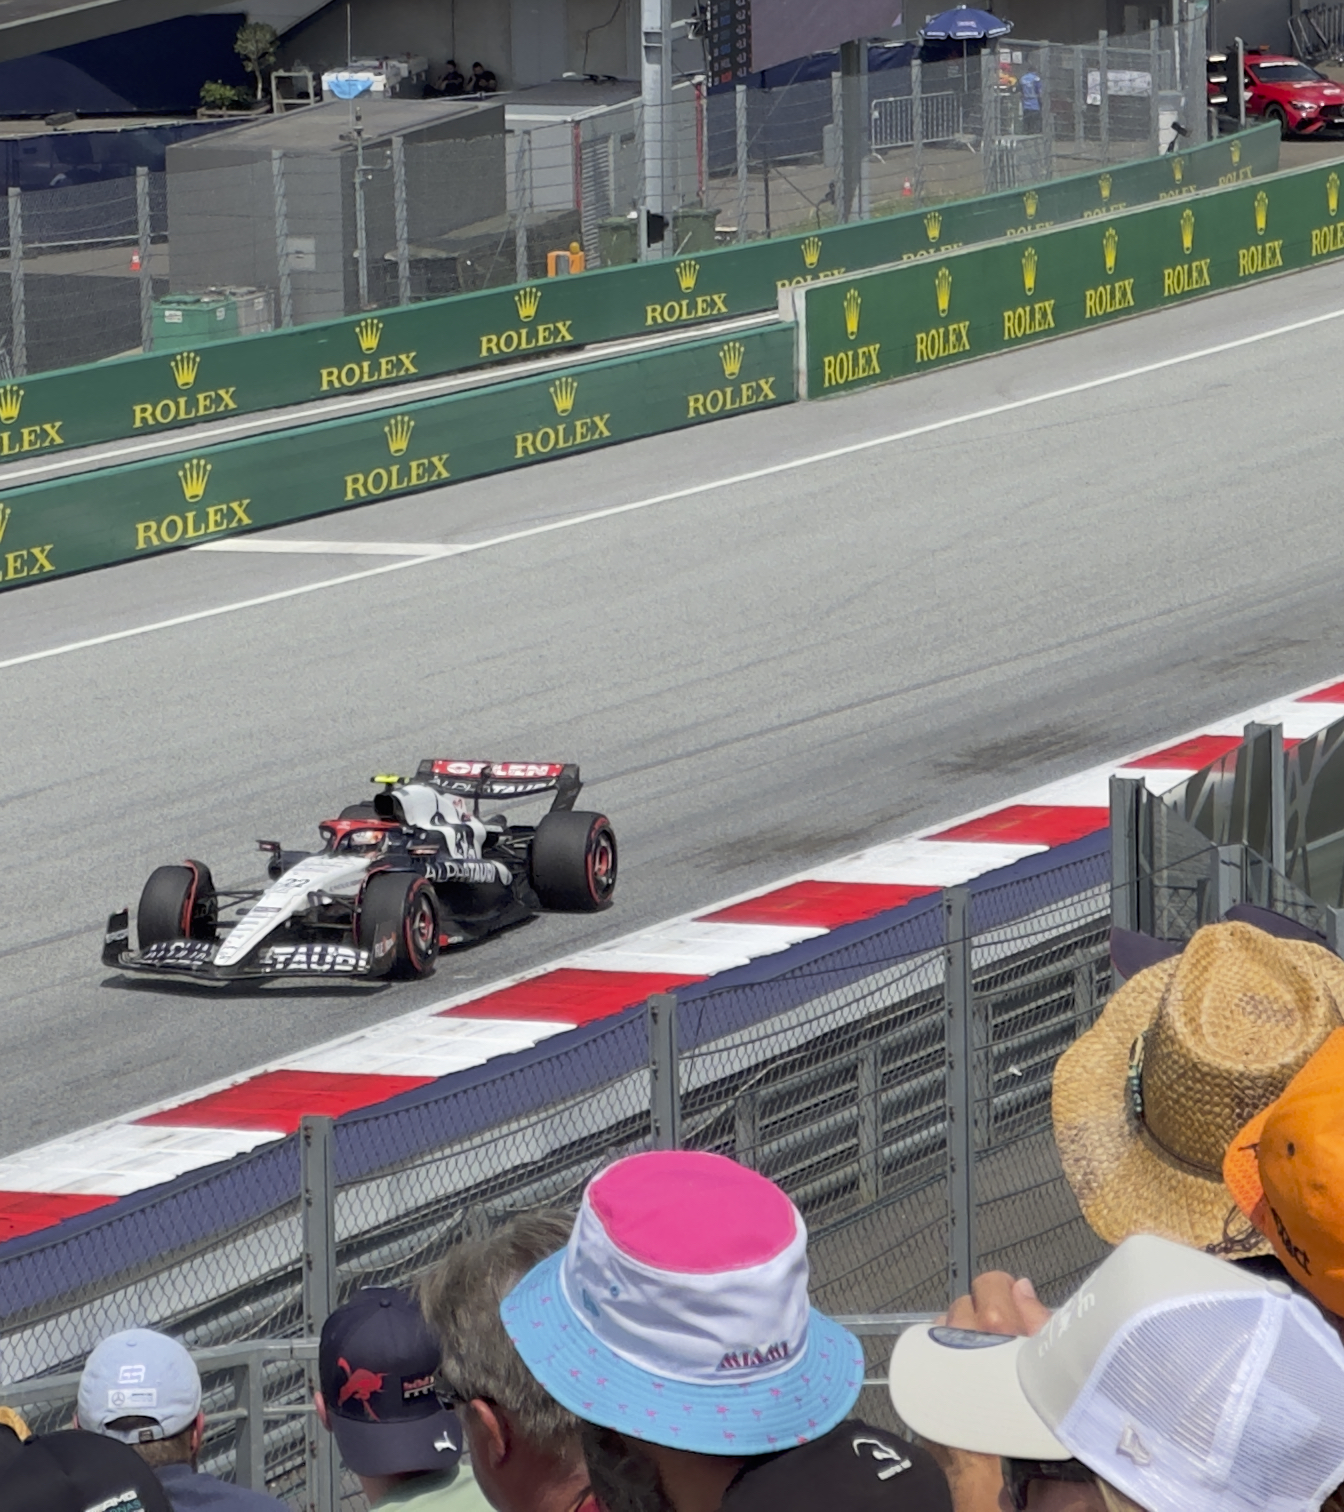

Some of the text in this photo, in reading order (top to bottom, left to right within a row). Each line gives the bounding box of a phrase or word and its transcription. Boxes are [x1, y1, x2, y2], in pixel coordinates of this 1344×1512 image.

[1238, 239, 1282, 275] ROLEX
[1163, 258, 1210, 295] ROLEX
[646, 294, 726, 325] ROLEX
[1085, 278, 1134, 317] ROLEX
[1002, 299, 1054, 339] ROLEX
[480, 321, 572, 356] ROLEX
[915, 320, 969, 360] ROLEX
[320, 352, 416, 389] ROLEX
[823, 343, 880, 386] ROLEX
[133, 388, 236, 427] ROLEX
[688, 378, 774, 415] ROLEX
[516, 414, 611, 458] ROLEX
[345, 455, 448, 499] ROLEX
[135, 499, 251, 548] ROLEX
[447, 763, 548, 778] ORLEN
[717, 1340, 791, 1371] MIAMI
